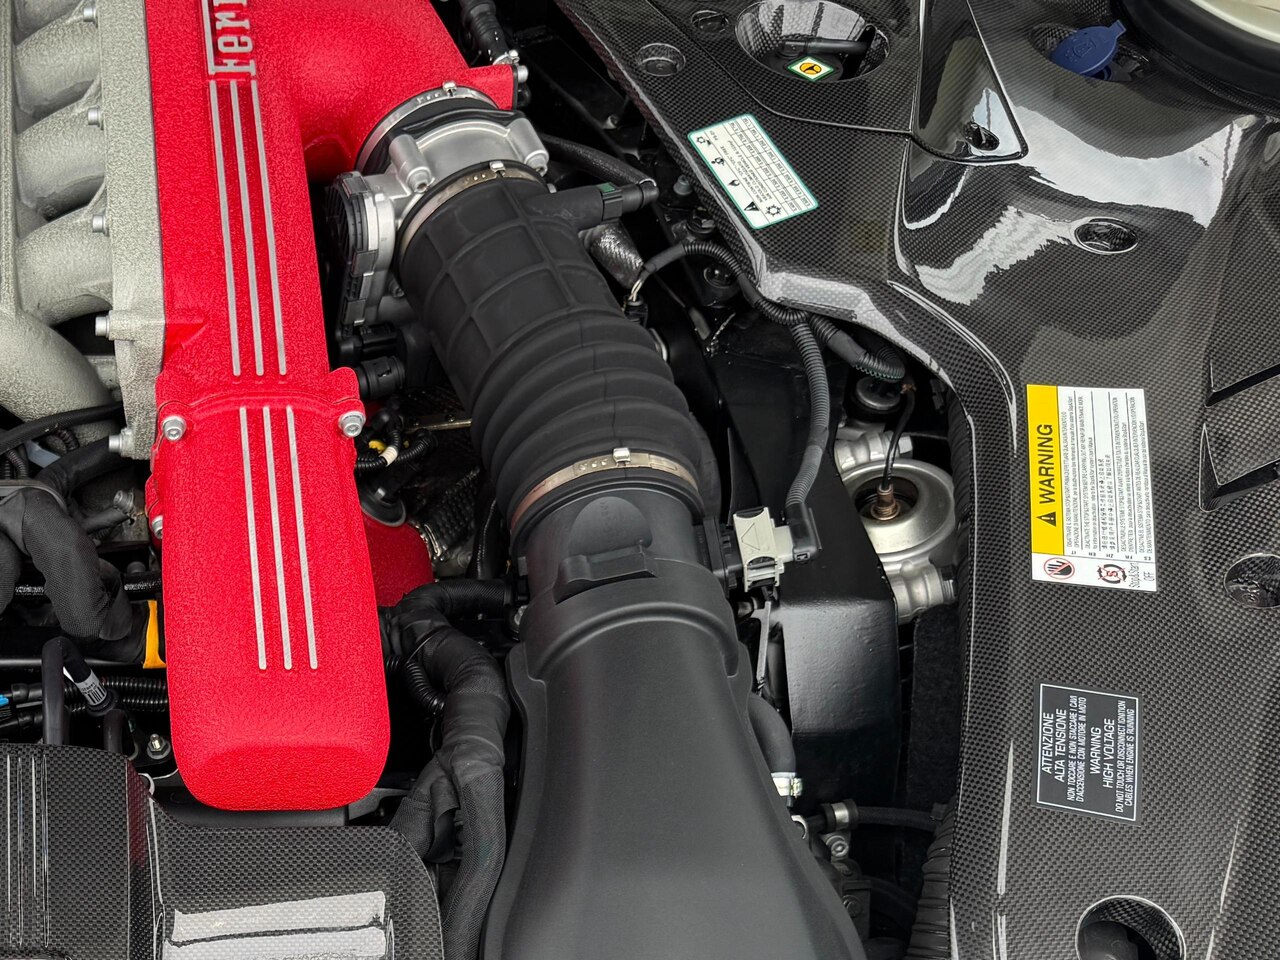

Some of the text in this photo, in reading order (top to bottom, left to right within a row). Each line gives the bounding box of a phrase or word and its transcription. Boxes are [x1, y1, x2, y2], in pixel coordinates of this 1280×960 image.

[1036, 424, 1055, 504] WARNING
[1143, 571, 1154, 581] OFF
[1041, 712, 1053, 773] ATTENZIONE
[1053, 708, 1066, 782] ALTA TENSIONE
[1089, 726, 1101, 774] WARNING
[1102, 718, 1114, 788] HIGH VOLTAGE
